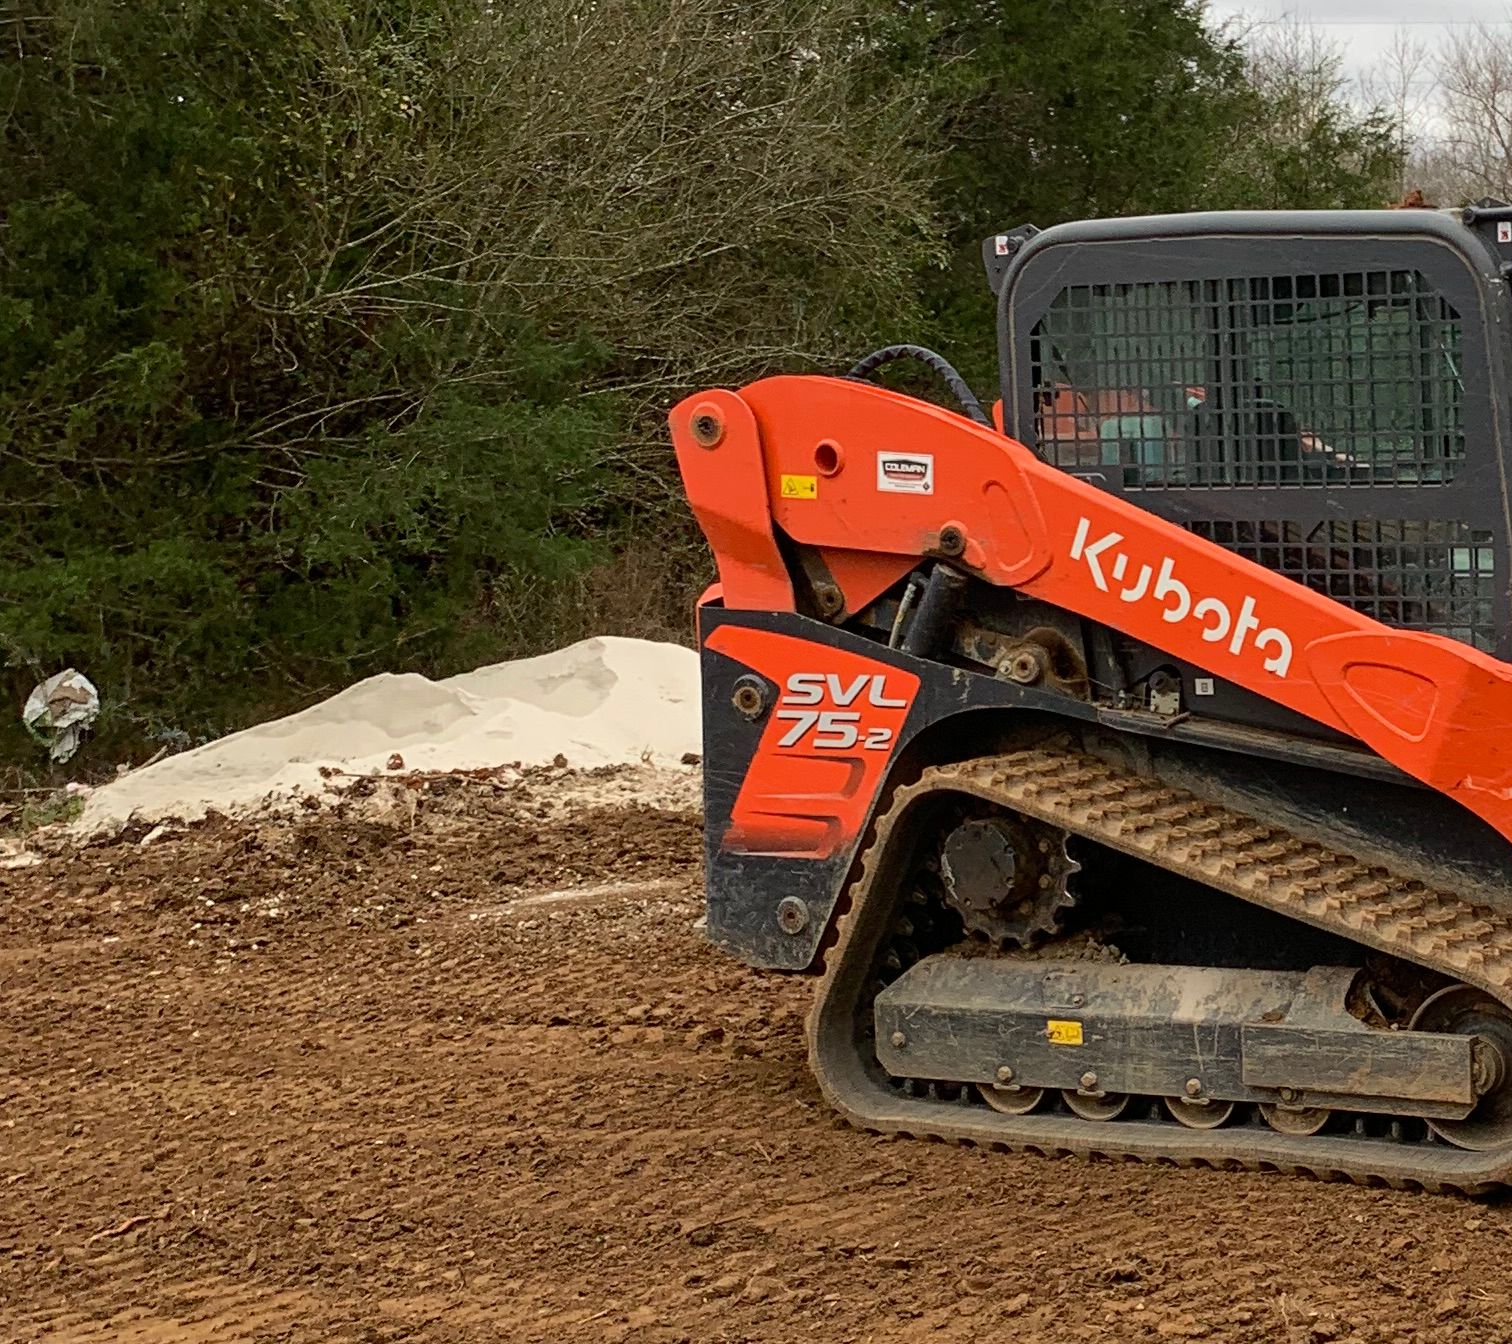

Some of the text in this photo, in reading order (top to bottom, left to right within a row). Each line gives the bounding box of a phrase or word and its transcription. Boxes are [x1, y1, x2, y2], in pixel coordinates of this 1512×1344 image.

[885, 462, 926, 473] COLEMAN
[1069, 517, 1293, 678] Kubota
[781, 673, 907, 708] SVL
[776, 709, 893, 750] 75-2
